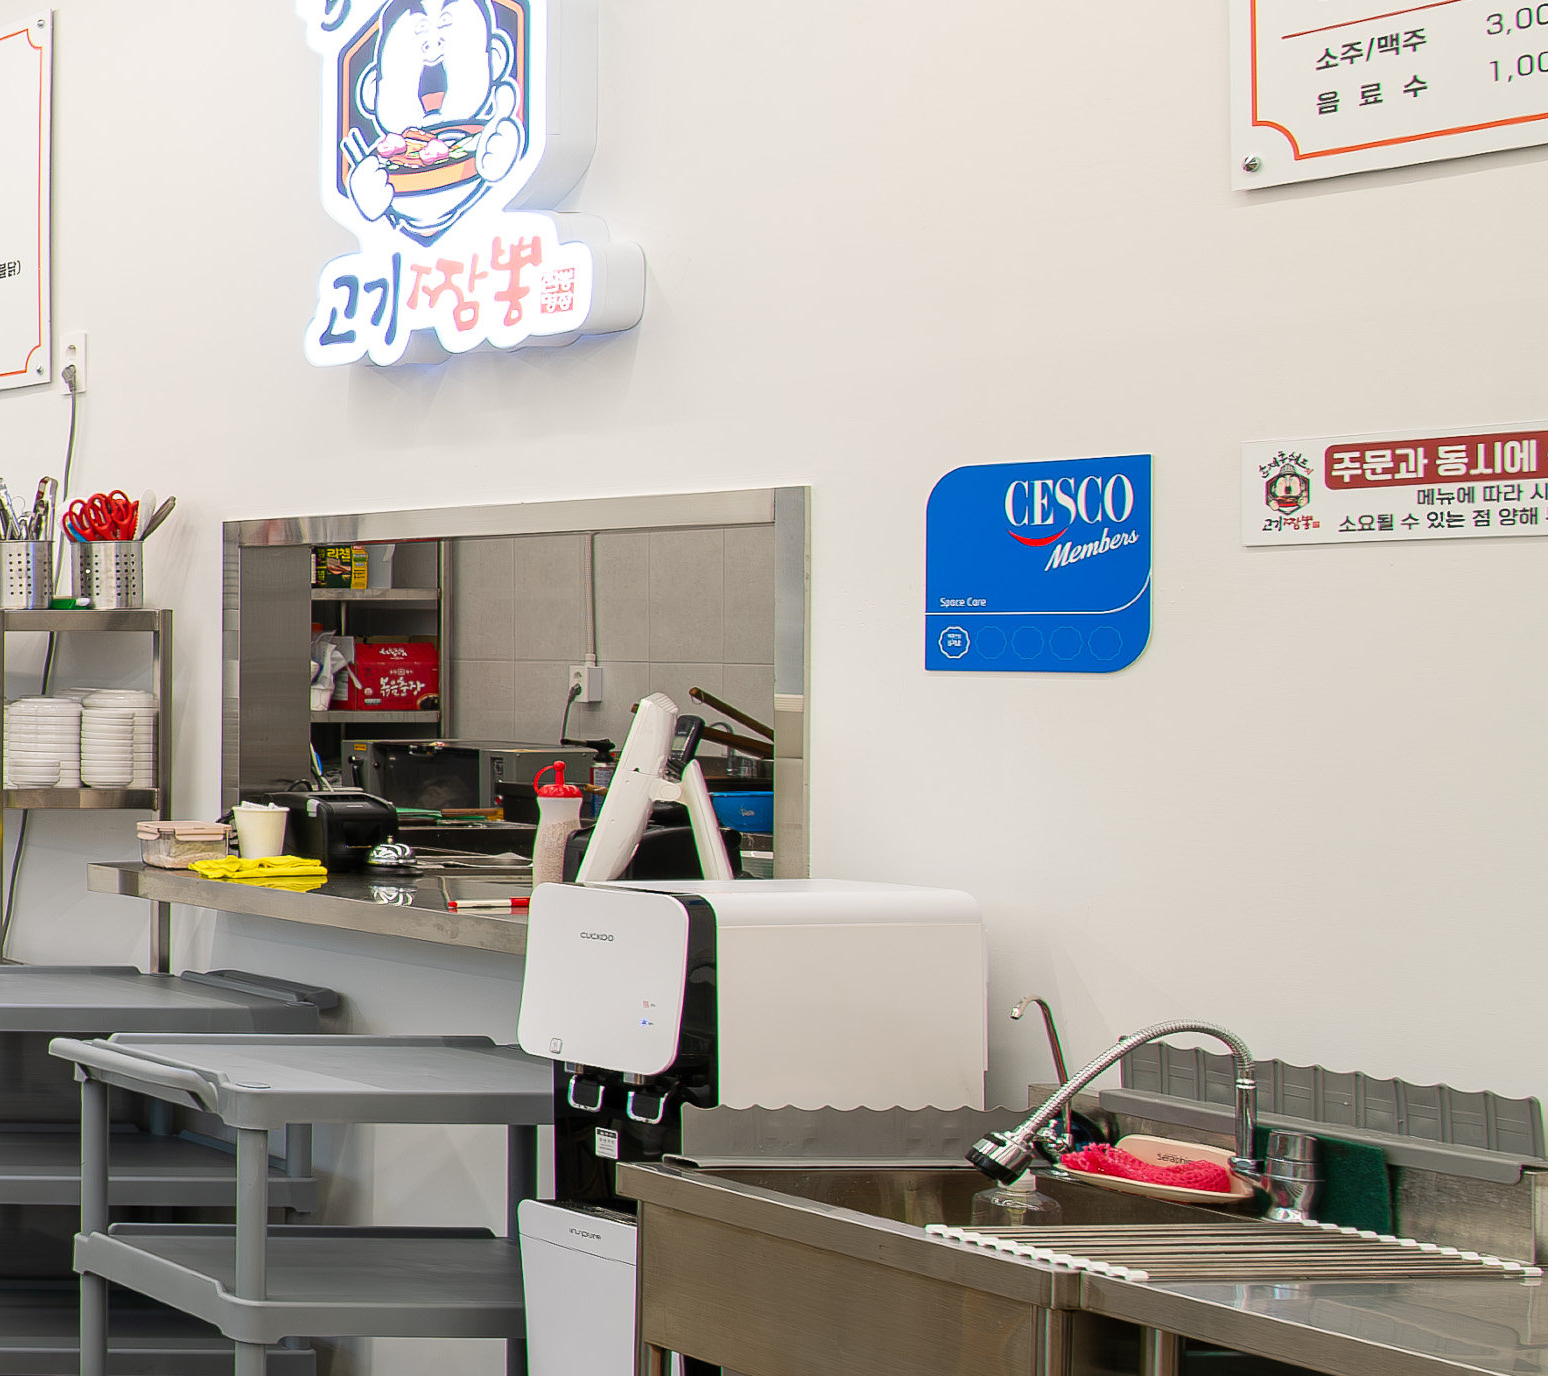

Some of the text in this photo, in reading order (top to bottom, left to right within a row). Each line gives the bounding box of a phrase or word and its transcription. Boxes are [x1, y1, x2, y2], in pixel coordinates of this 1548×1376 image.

[1315, 27, 1428, 72] 소주/맥주
[319, 235, 542, 346] 고기짬뽕
[1331, 438, 1538, 483] 주문과 동시에
[1003, 472, 1135, 528] CESCO
[1416, 484, 1476, 507] 메뉴에
[1483, 483, 1524, 503] 따라
[1338, 506, 1540, 533] 소요될 수 있는 점 양해
[1044, 527, 1140, 572] Members
[939, 596, 987, 609] Space Care
[580, 931, 615, 943] CUCKOO
